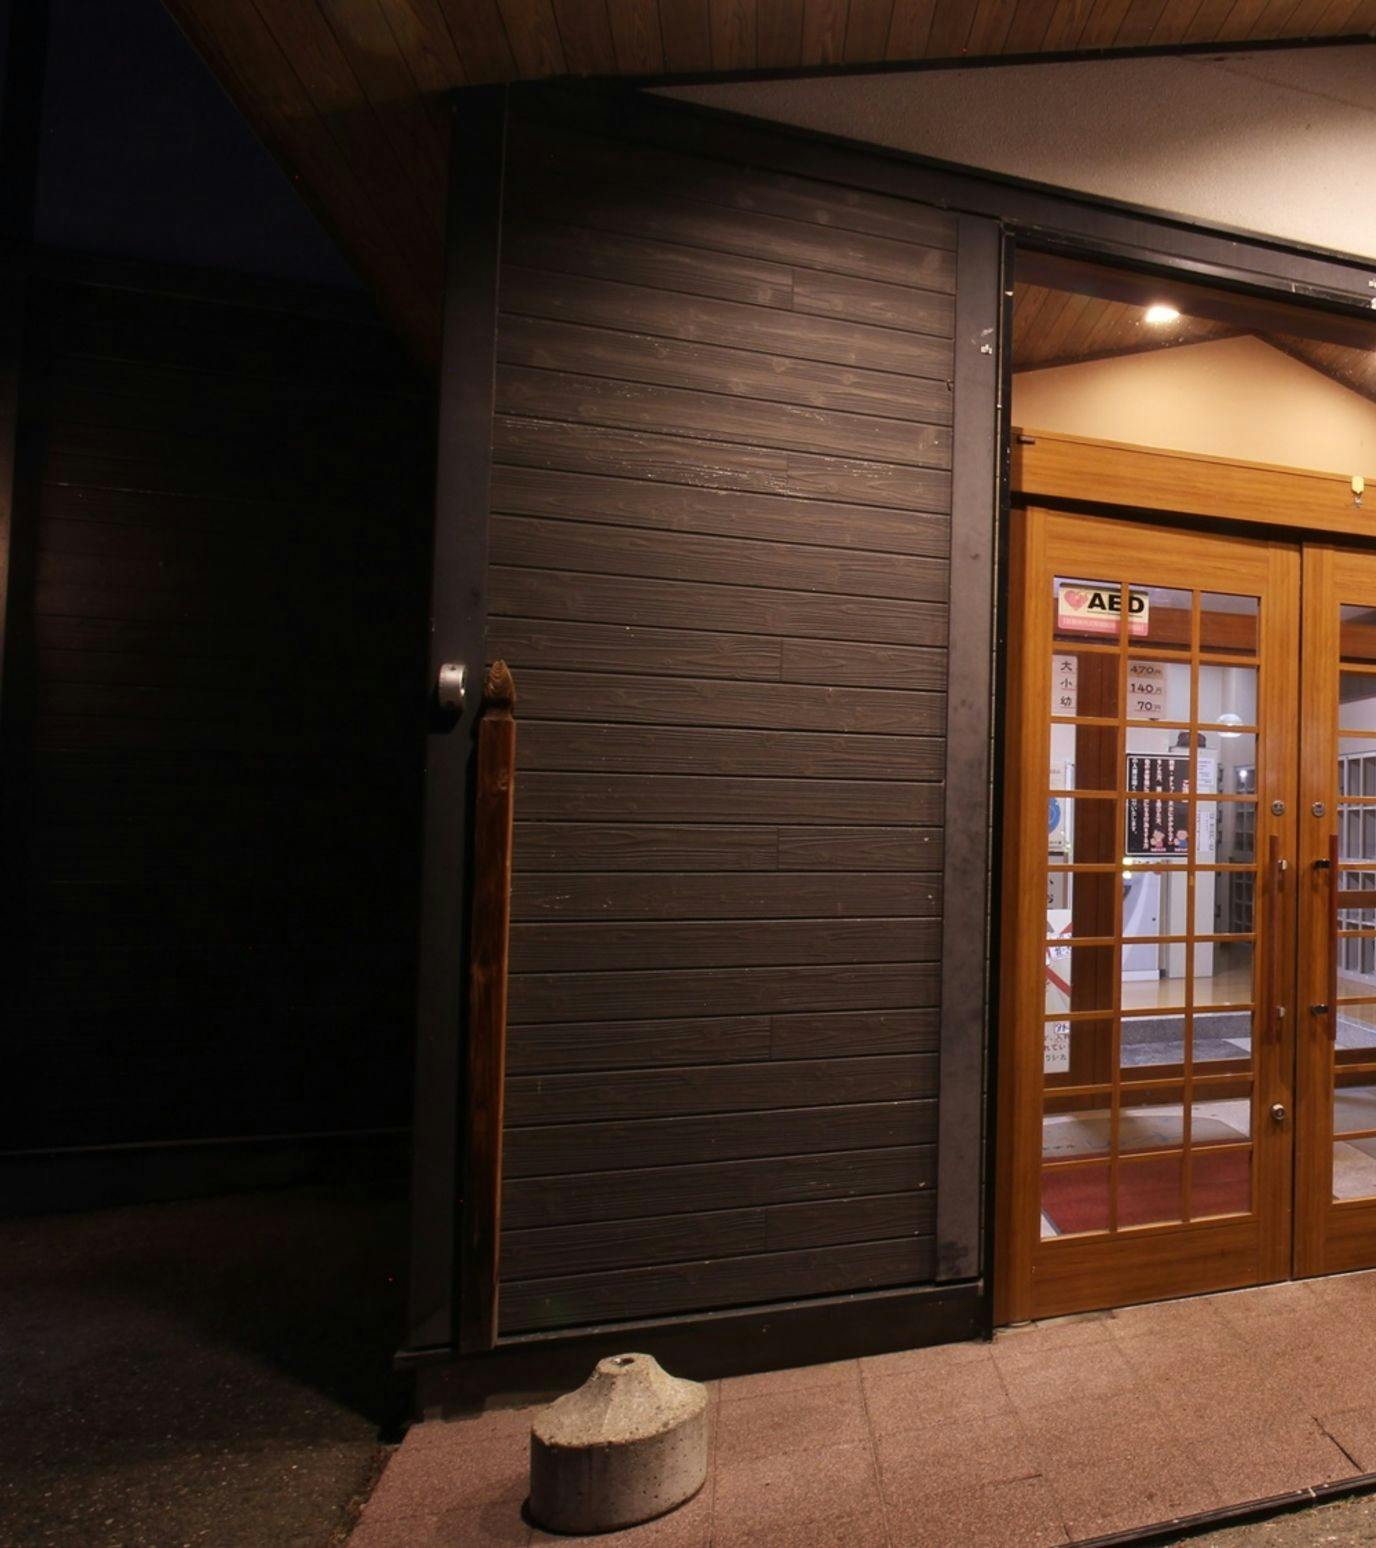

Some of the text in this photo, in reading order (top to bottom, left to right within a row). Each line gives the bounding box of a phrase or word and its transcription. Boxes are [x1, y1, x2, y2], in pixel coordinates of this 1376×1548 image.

[1088, 592, 1145, 614] AED
[1060, 660, 1073, 672] 大
[1060, 678, 1073, 688] 小
